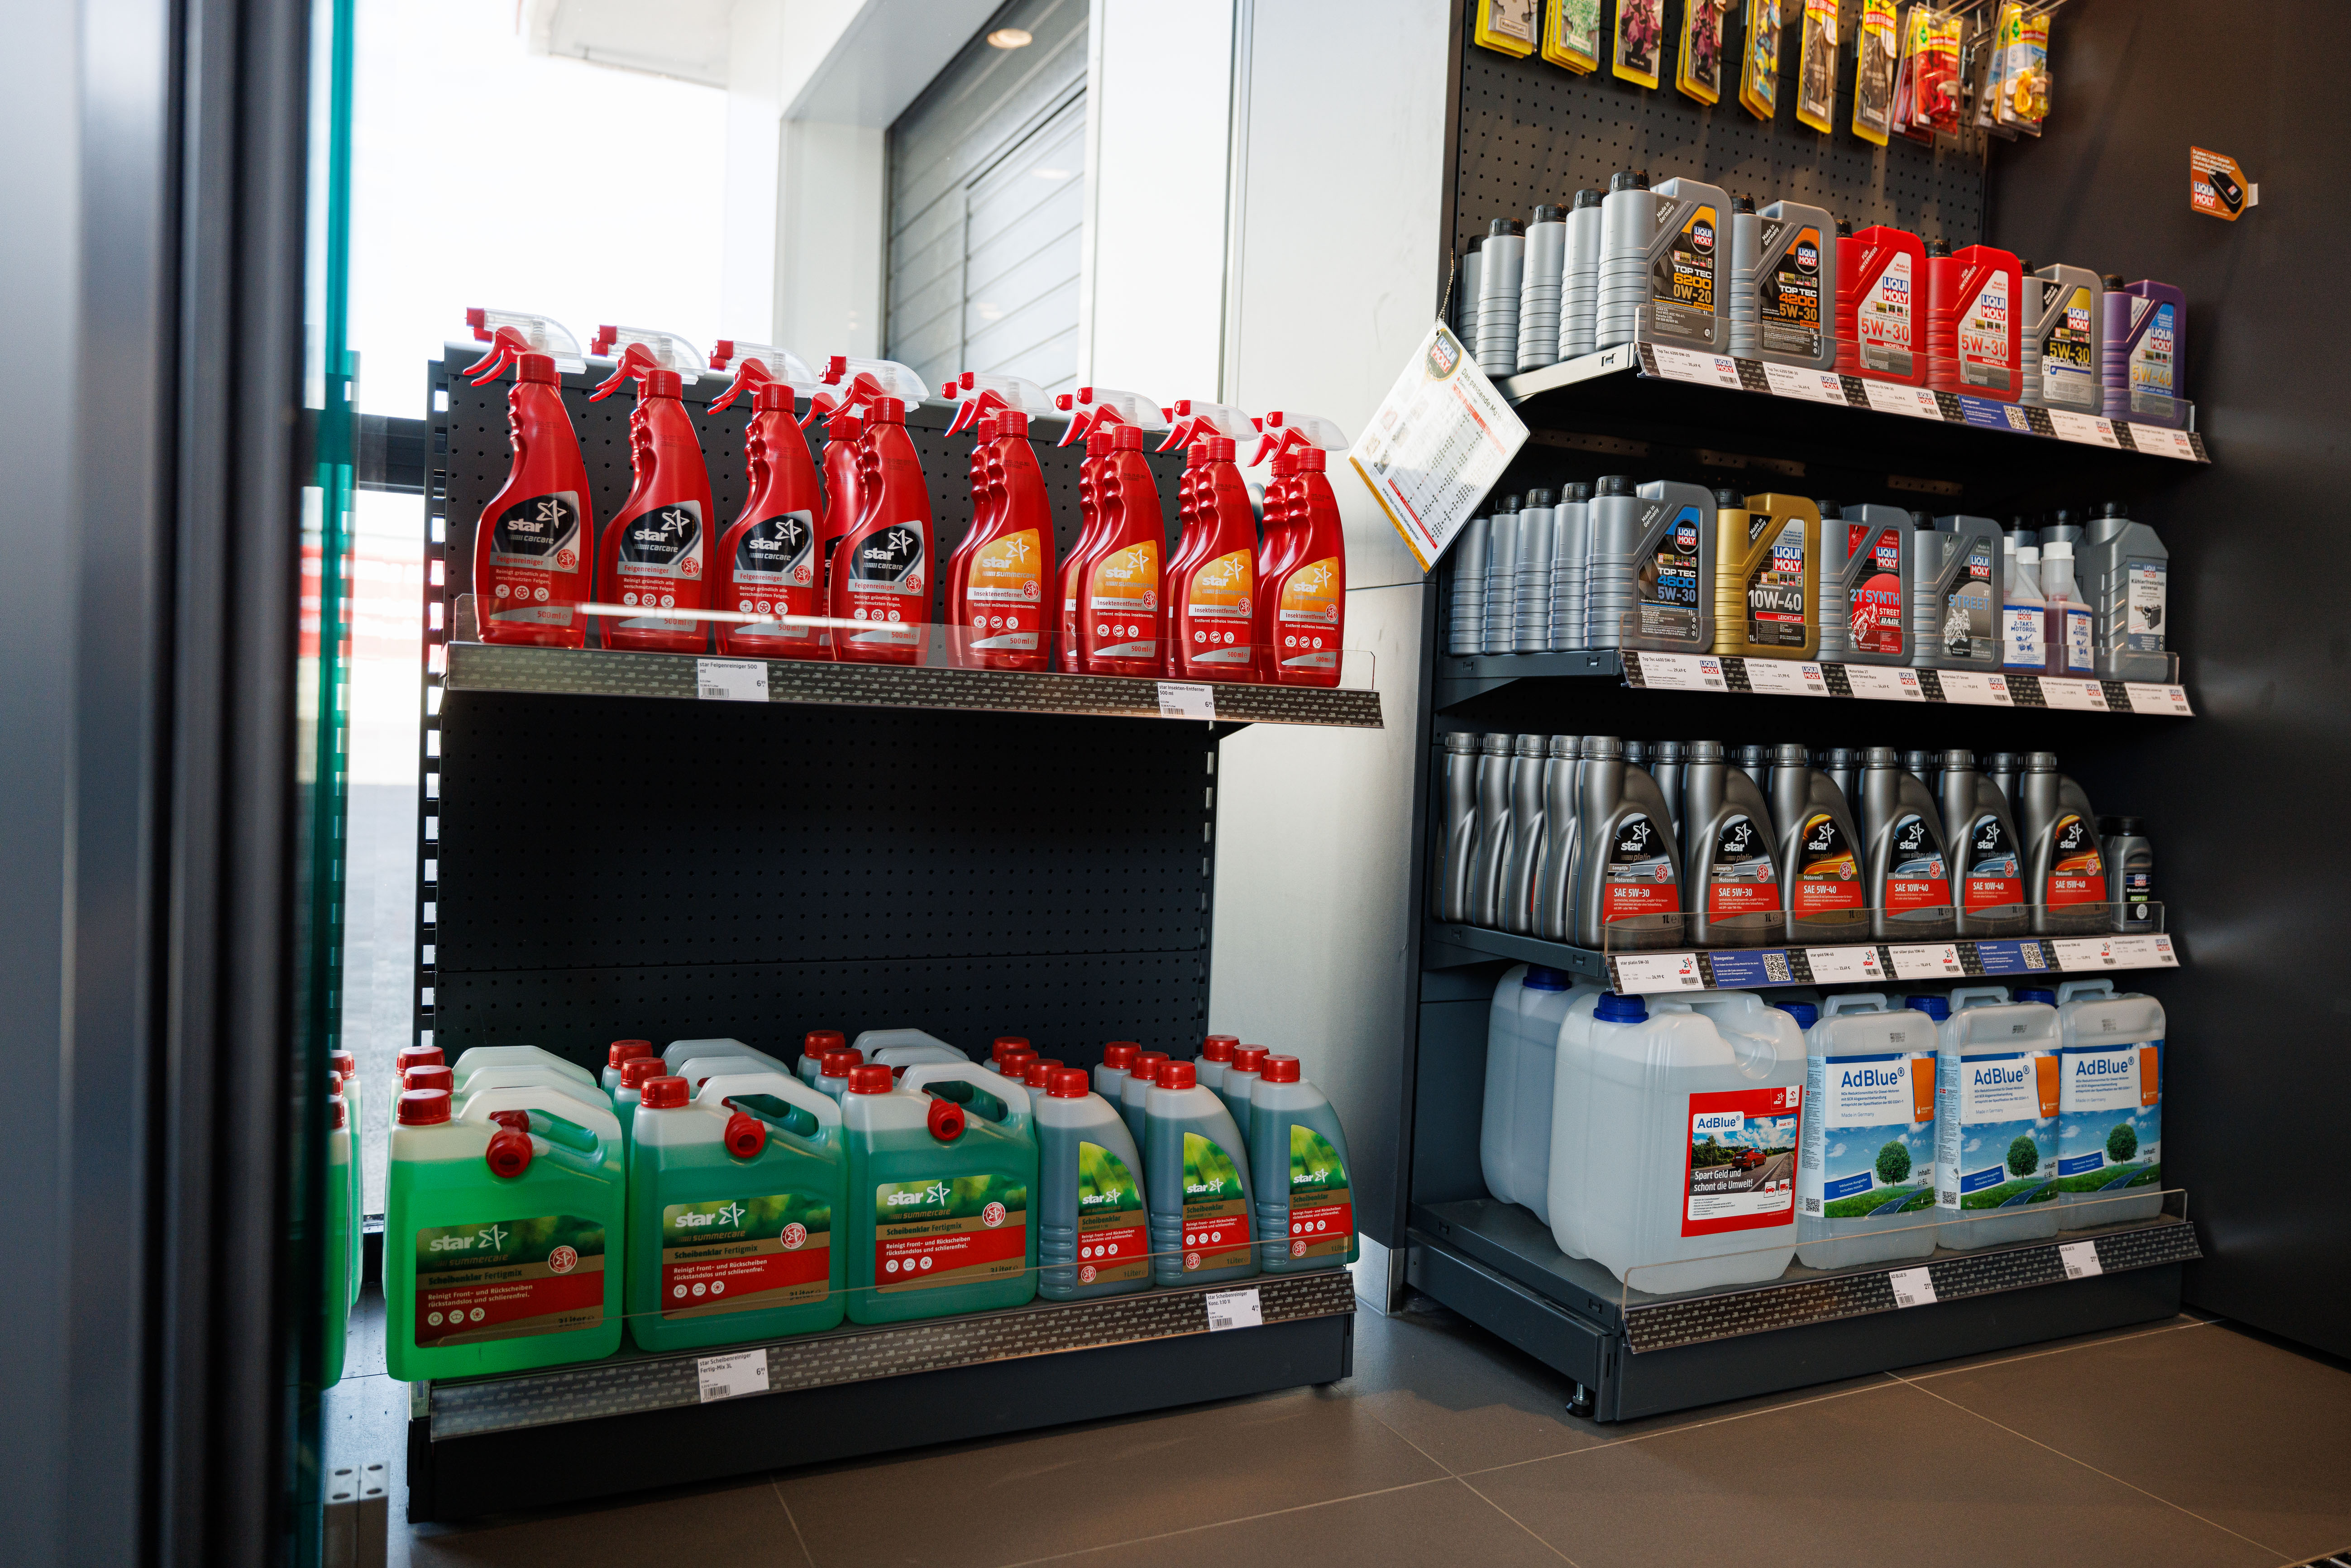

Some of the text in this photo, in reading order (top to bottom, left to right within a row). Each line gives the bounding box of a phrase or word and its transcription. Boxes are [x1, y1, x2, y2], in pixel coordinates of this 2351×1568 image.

[2195, 182, 2214, 196] LIQUI
[2195, 193, 2215, 206] MOLY
[1659, 203, 1675, 223] Germany
[1798, 248, 1816, 258] LIQUI
[1859, 246, 1878, 272] UNTERWEGS
[1798, 256, 1816, 266] MOLY
[1674, 265, 1712, 278] TOP TEC
[1674, 272, 1711, 290] 6200
[1884, 277, 1908, 292] LIQUI
[1674, 284, 1711, 303] 0W-20
[1884, 291, 1908, 304] MOLY
[1779, 294, 1817, 307] 4200
[2069, 308, 2088, 320] LIQUI
[1861, 318, 1909, 342] 5W-30
[2069, 319, 2089, 331] MOLY
[1884, 342, 1909, 350] NACHFÜLL-ÖL
[1961, 335, 2007, 357] 5W-30
[2050, 343, 2089, 362] 5W-30
[2043, 355, 2073, 365] SPECIAL
[2132, 365, 2172, 385] 5W-40
[1461, 368, 1491, 407] Das passende
[1383, 488, 1419, 540] www.liqui-moly.de/oelwegweiser
[508, 518, 543, 532] star
[634, 529, 668, 542] star
[1678, 528, 1696, 537] LIQUI
[1678, 536, 1696, 545] MOLY
[497, 556, 543, 566] Felgenreiniger
[983, 557, 1012, 568] star
[625, 565, 669, 575] Felgenreiniger
[1294, 582, 1318, 593] star
[1658, 575, 1696, 588] 4600
[1749, 590, 1801, 611] 10W-40
[1850, 589, 1900, 605] 2T SYNTH
[1949, 594, 1989, 610] STREET
[1725, 842, 1745, 851] star
[1634, 853, 1651, 862] platin
[1614, 888, 1649, 897] SAE 5W-30
[1804, 885, 1836, 894] SAE 5W-40
[1695, 1169, 1741, 1181] Spart Geld und
[1187, 1183, 1208, 1194] star
[1694, 1179, 1753, 1192] schont die Umwelt!
[1293, 1194, 1328, 1203] Scheibenklar
[675, 1211, 715, 1227] star
[449, 1254, 508, 1267] summercare
[730, 1259, 767, 1268] Rückscheiben
[485, 1269, 522, 1280] Fertigmix
[674, 1272, 713, 1280] rückstandslos
[728, 1267, 764, 1276] schlierenfrei.
[711, 1353, 751, 1364] Scheibenreiniger
